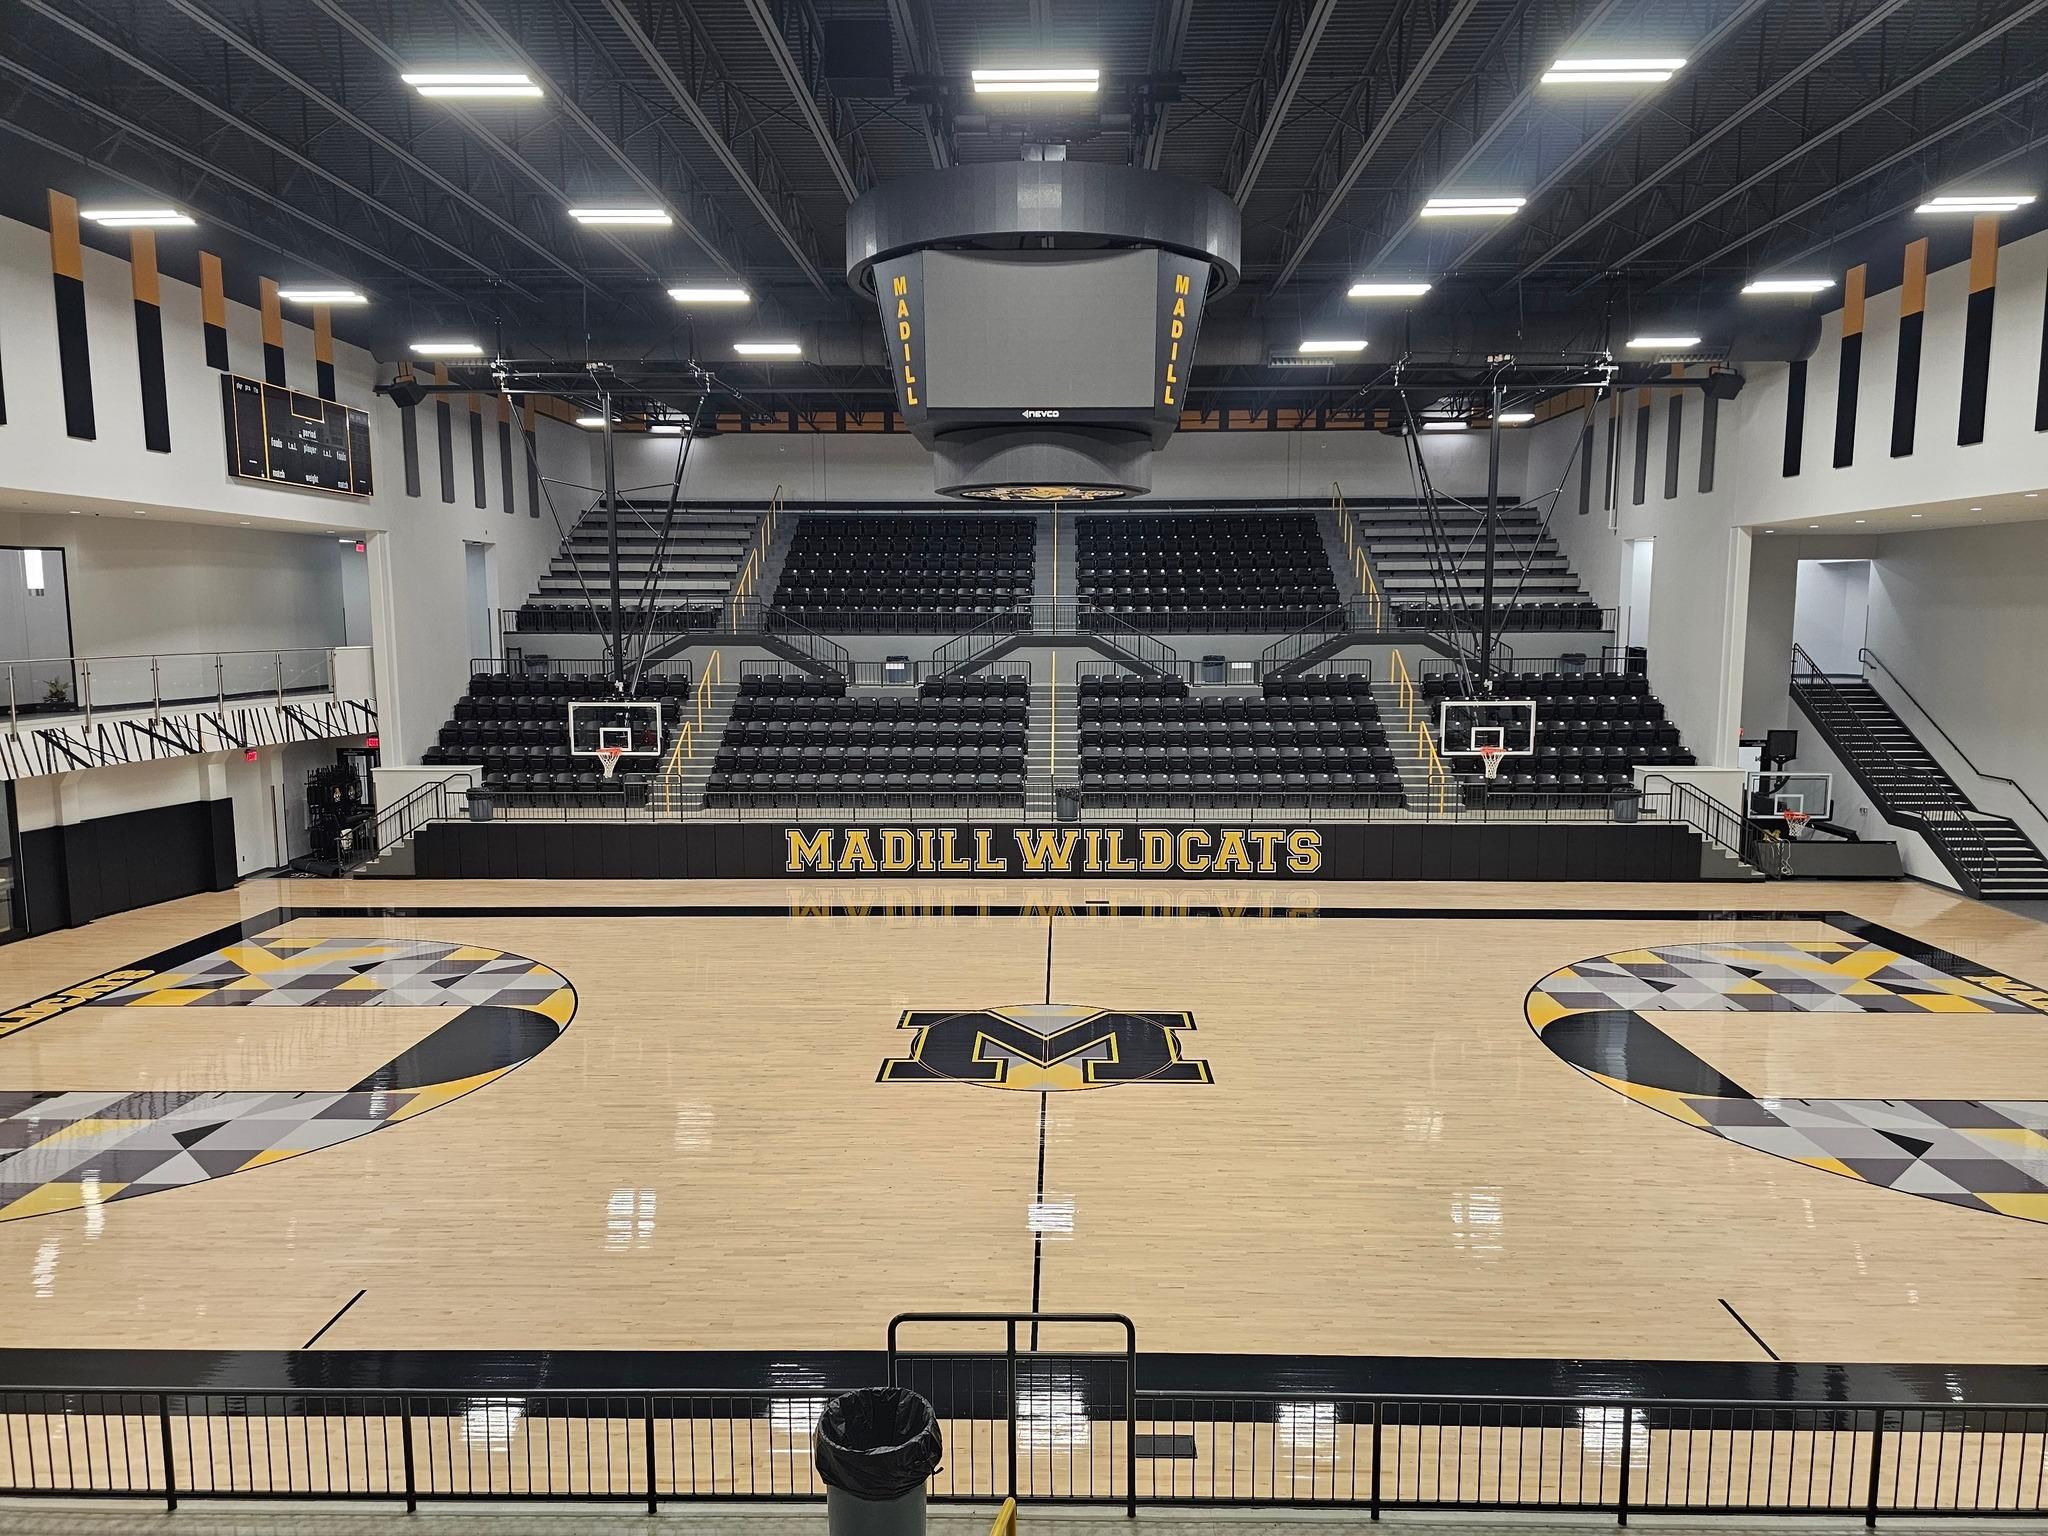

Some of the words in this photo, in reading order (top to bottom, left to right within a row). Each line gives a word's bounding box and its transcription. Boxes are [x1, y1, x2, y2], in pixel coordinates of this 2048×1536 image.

[893, 276, 918, 406] MADILL
[1163, 274, 1190, 405] MADILL
[302, 429, 317, 439] period
[303, 443, 317, 455] player
[785, 829, 1007, 871] MADILL
[1013, 828, 1322, 873] WILDCATS
